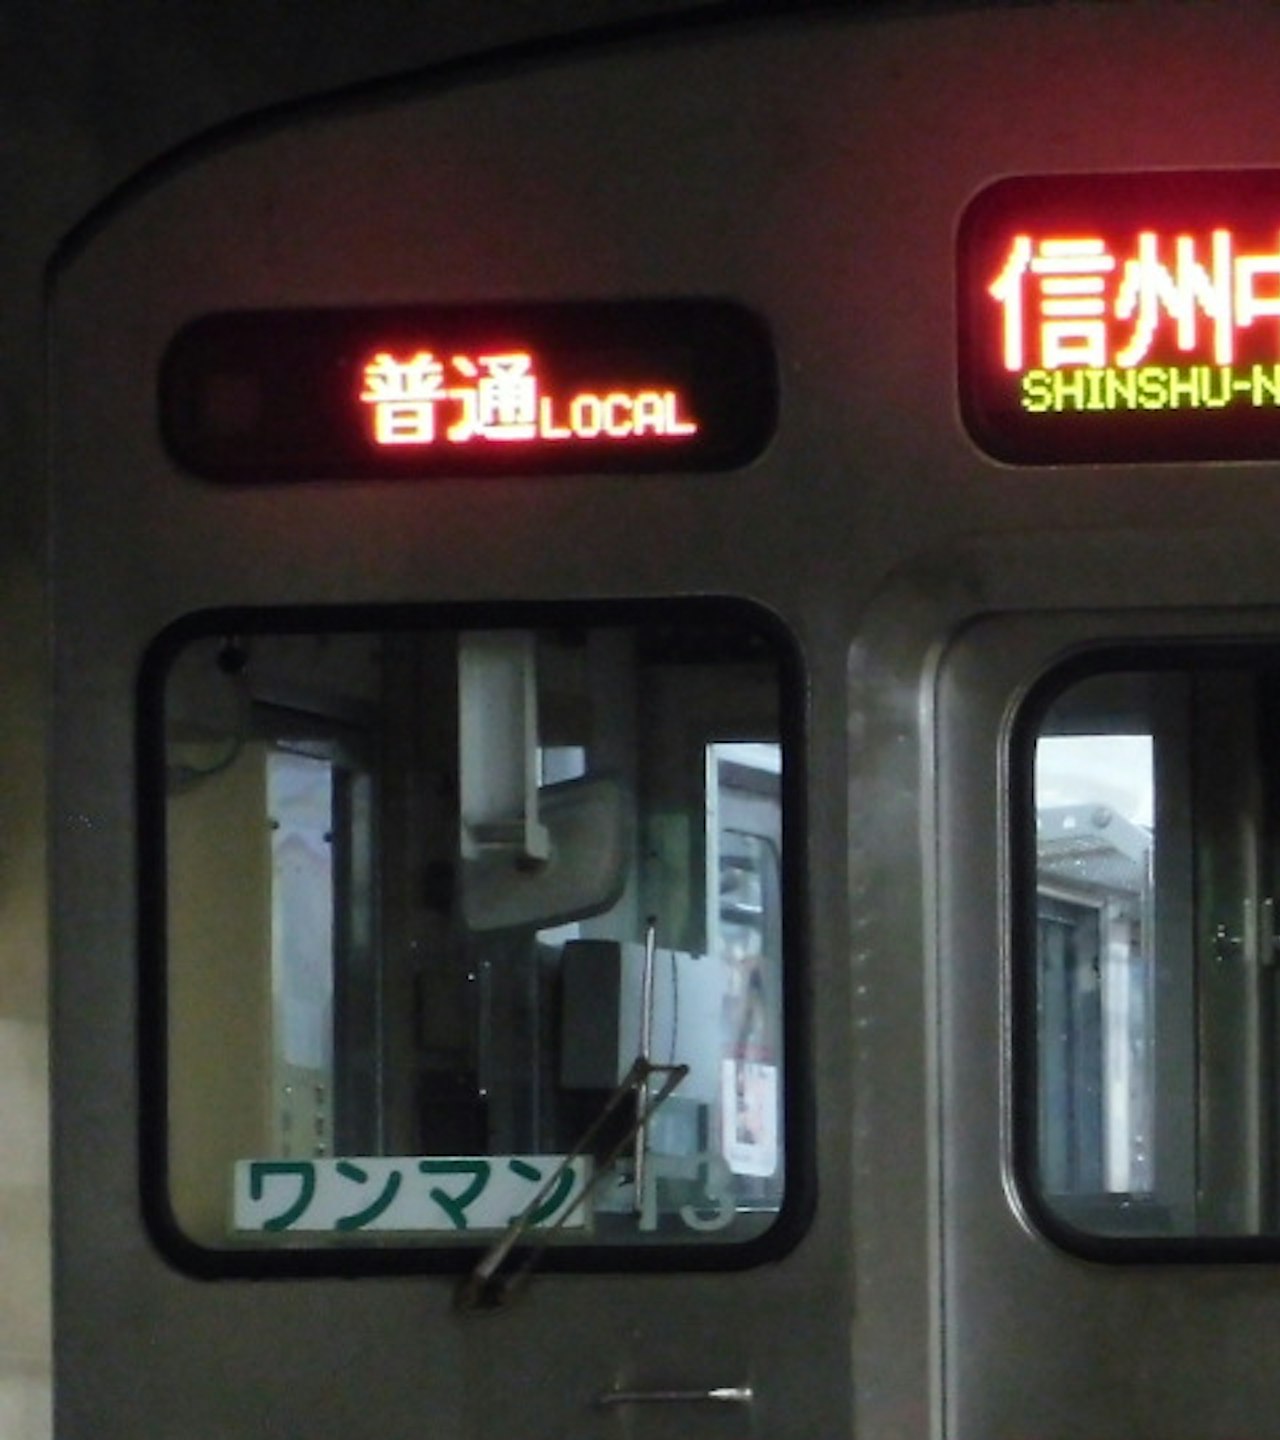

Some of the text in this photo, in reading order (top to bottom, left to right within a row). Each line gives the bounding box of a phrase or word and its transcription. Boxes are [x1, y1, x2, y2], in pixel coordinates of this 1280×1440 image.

[359, 352, 538, 444] 普通
[540, 391, 697, 440] LOCAL
[250, 1159, 576, 1232] ワンマン
